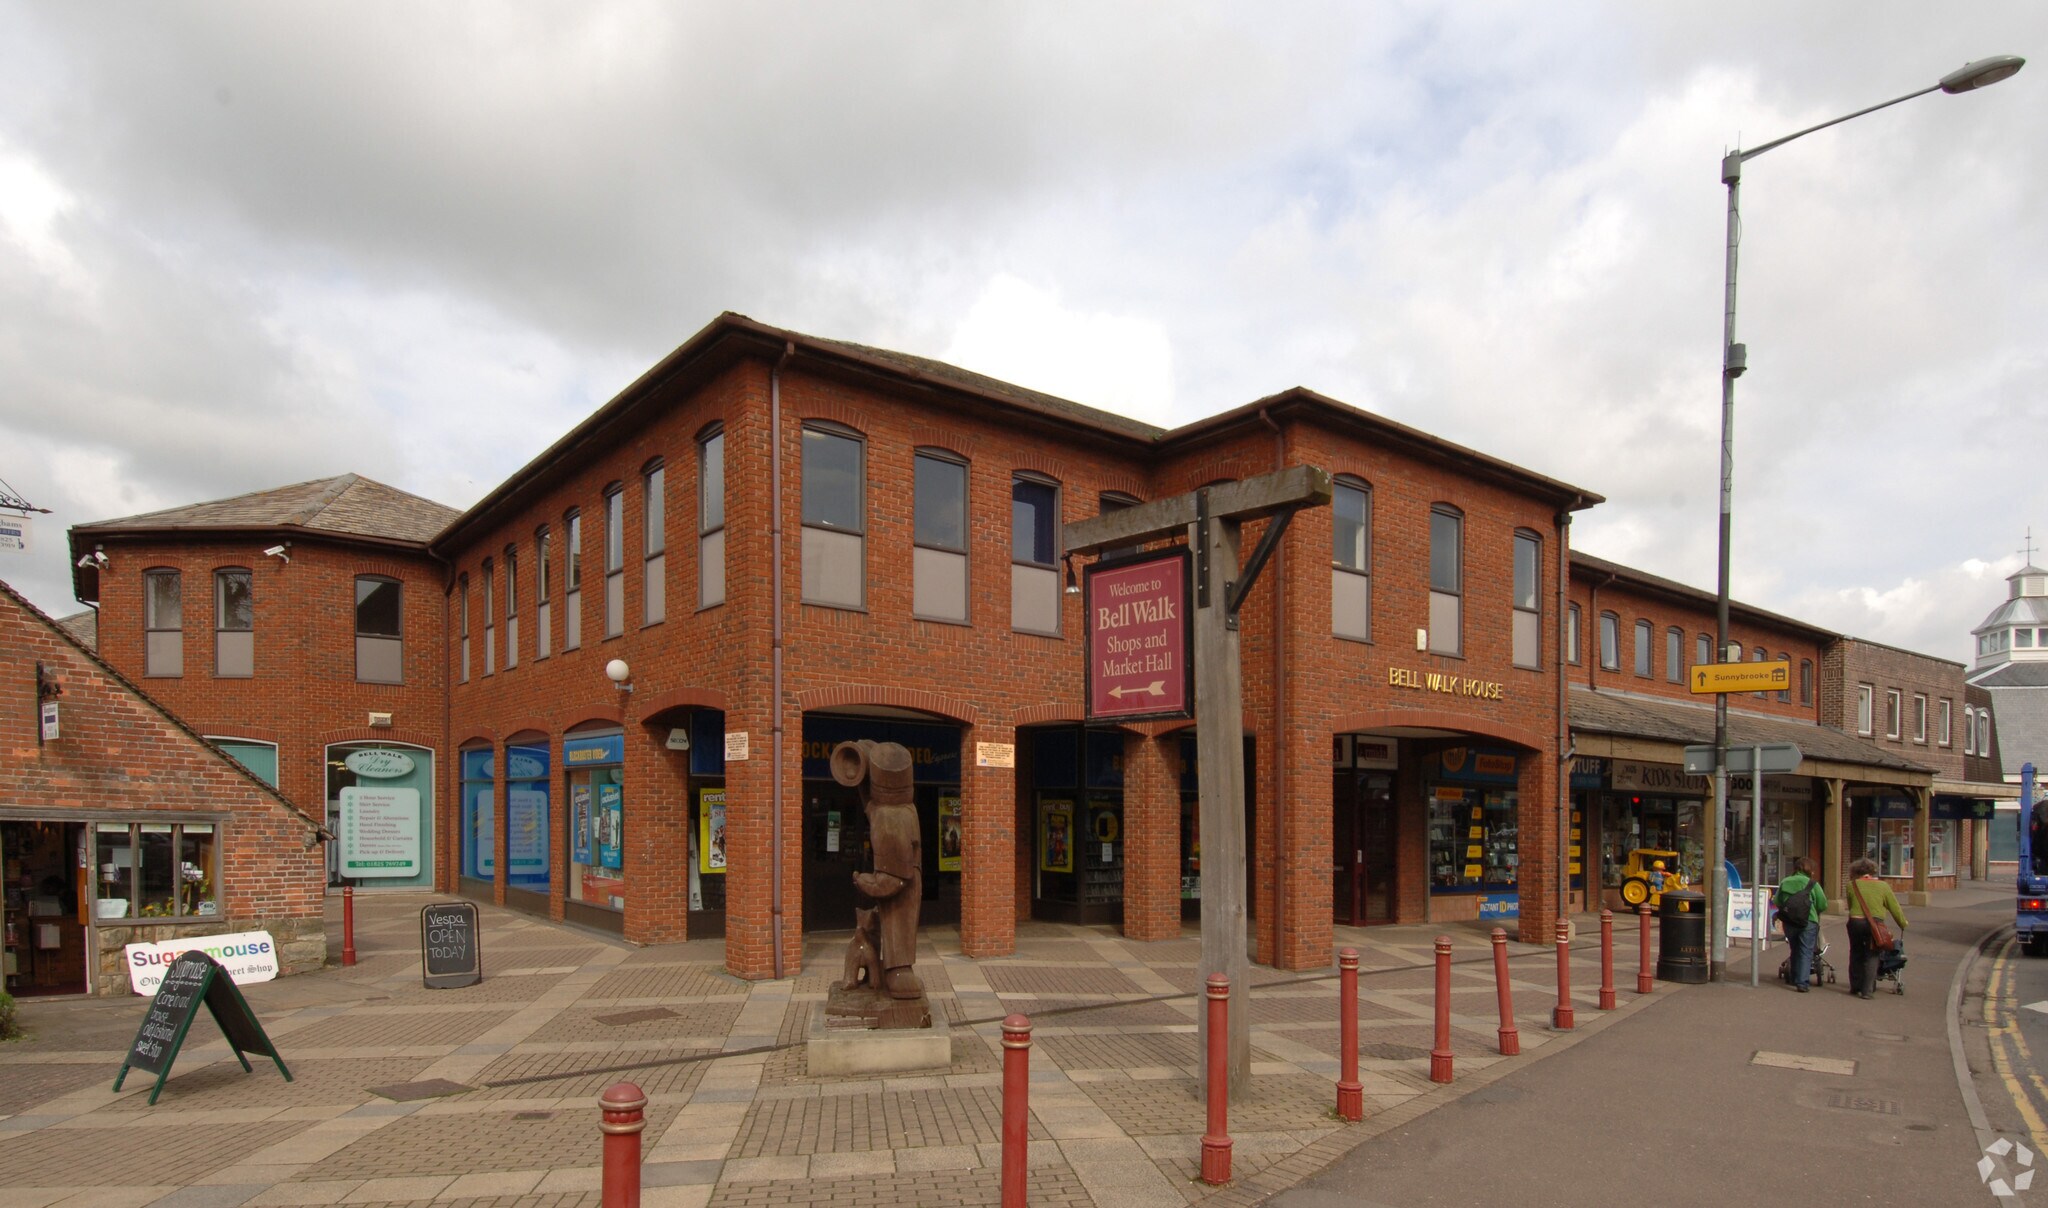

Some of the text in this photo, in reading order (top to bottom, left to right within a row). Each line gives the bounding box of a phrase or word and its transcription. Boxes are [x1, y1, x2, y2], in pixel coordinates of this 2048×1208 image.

[1109, 579, 1161, 597] Welcome to
[1097, 595, 1176, 630] Bell Walk
[1107, 628, 1167, 655] Shops and
[1102, 651, 1172, 678] Market Hall
[1389, 667, 1503, 699] BELL WALK HOUSE
[1714, 672, 1769, 681] Sunnybrooke
[380, 751, 402, 759] WALK
[911, 747, 931, 763] DEO
[358, 763, 402, 773] Cleaners
[1641, 766, 1671, 787] KIDS
[703, 793, 725, 802] rent
[429, 912, 467, 930] Vespa
[429, 929, 466, 943] OPEN
[140, 976, 161, 987] Old
[246, 963, 273, 976] Shop
